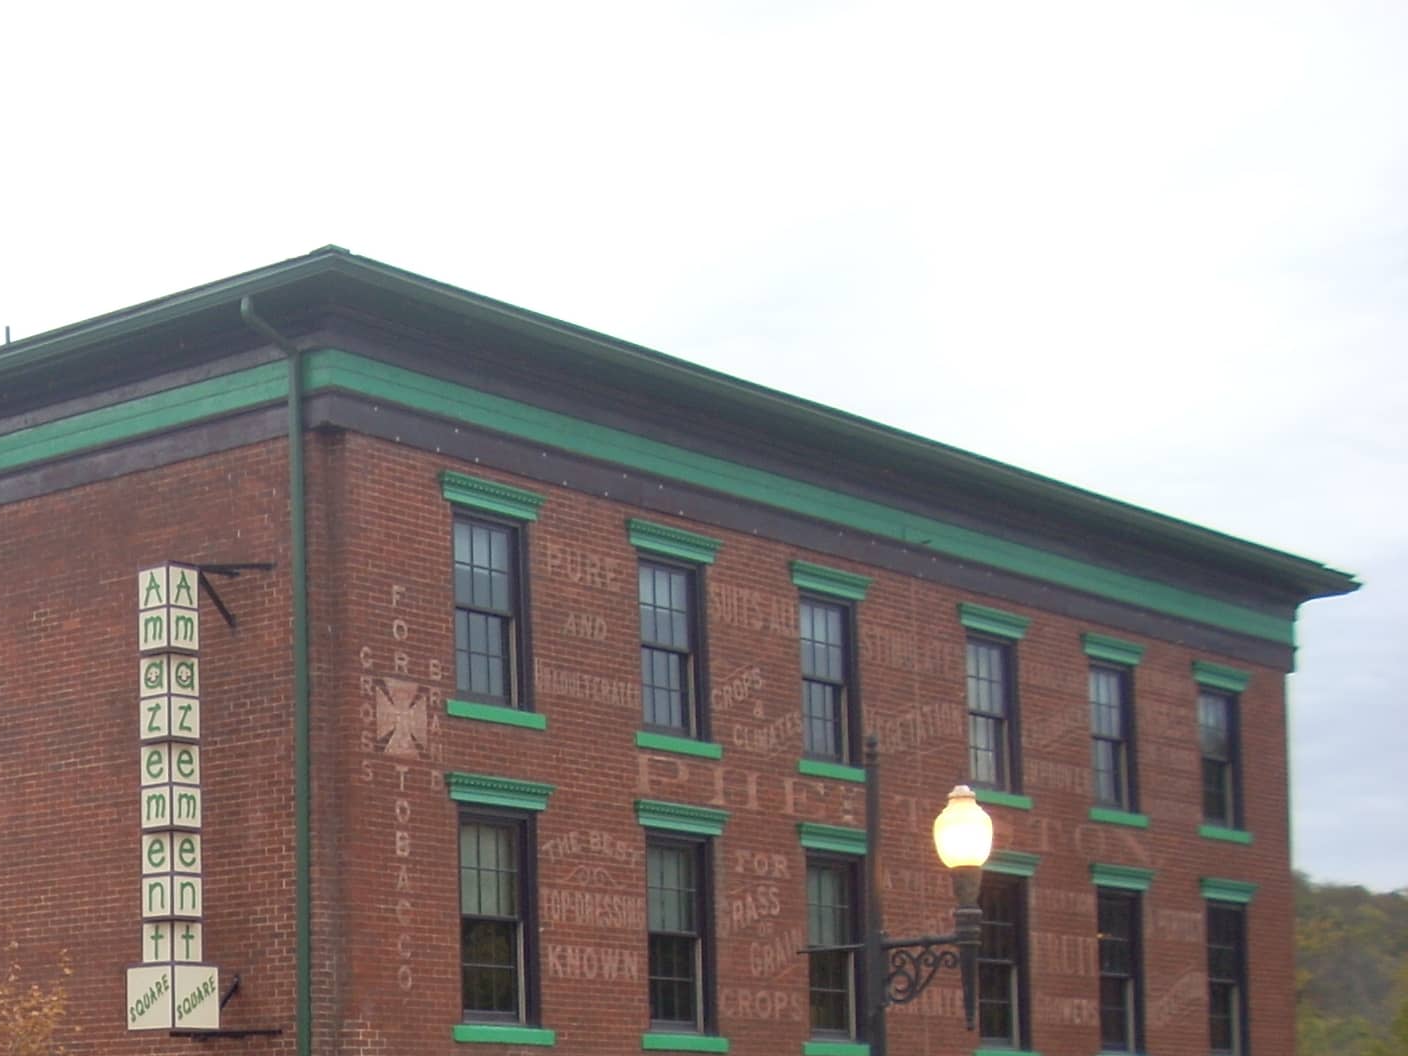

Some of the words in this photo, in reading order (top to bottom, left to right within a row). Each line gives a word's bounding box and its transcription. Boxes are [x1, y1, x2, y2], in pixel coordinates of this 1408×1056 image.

[547, 541, 622, 592] PURE
[391, 584, 409, 675] FOR
[563, 612, 608, 641] AND
[711, 667, 763, 711] CROPS
[541, 831, 580, 864] THE
[588, 831, 641, 868] BEST
[395, 765, 413, 992] TOBACCO
[548, 944, 639, 982] KNOWN
[129, 974, 169, 1023] SQUARE
[176, 974, 216, 1021] SQUARE
[719, 987, 804, 1021] CROPS
